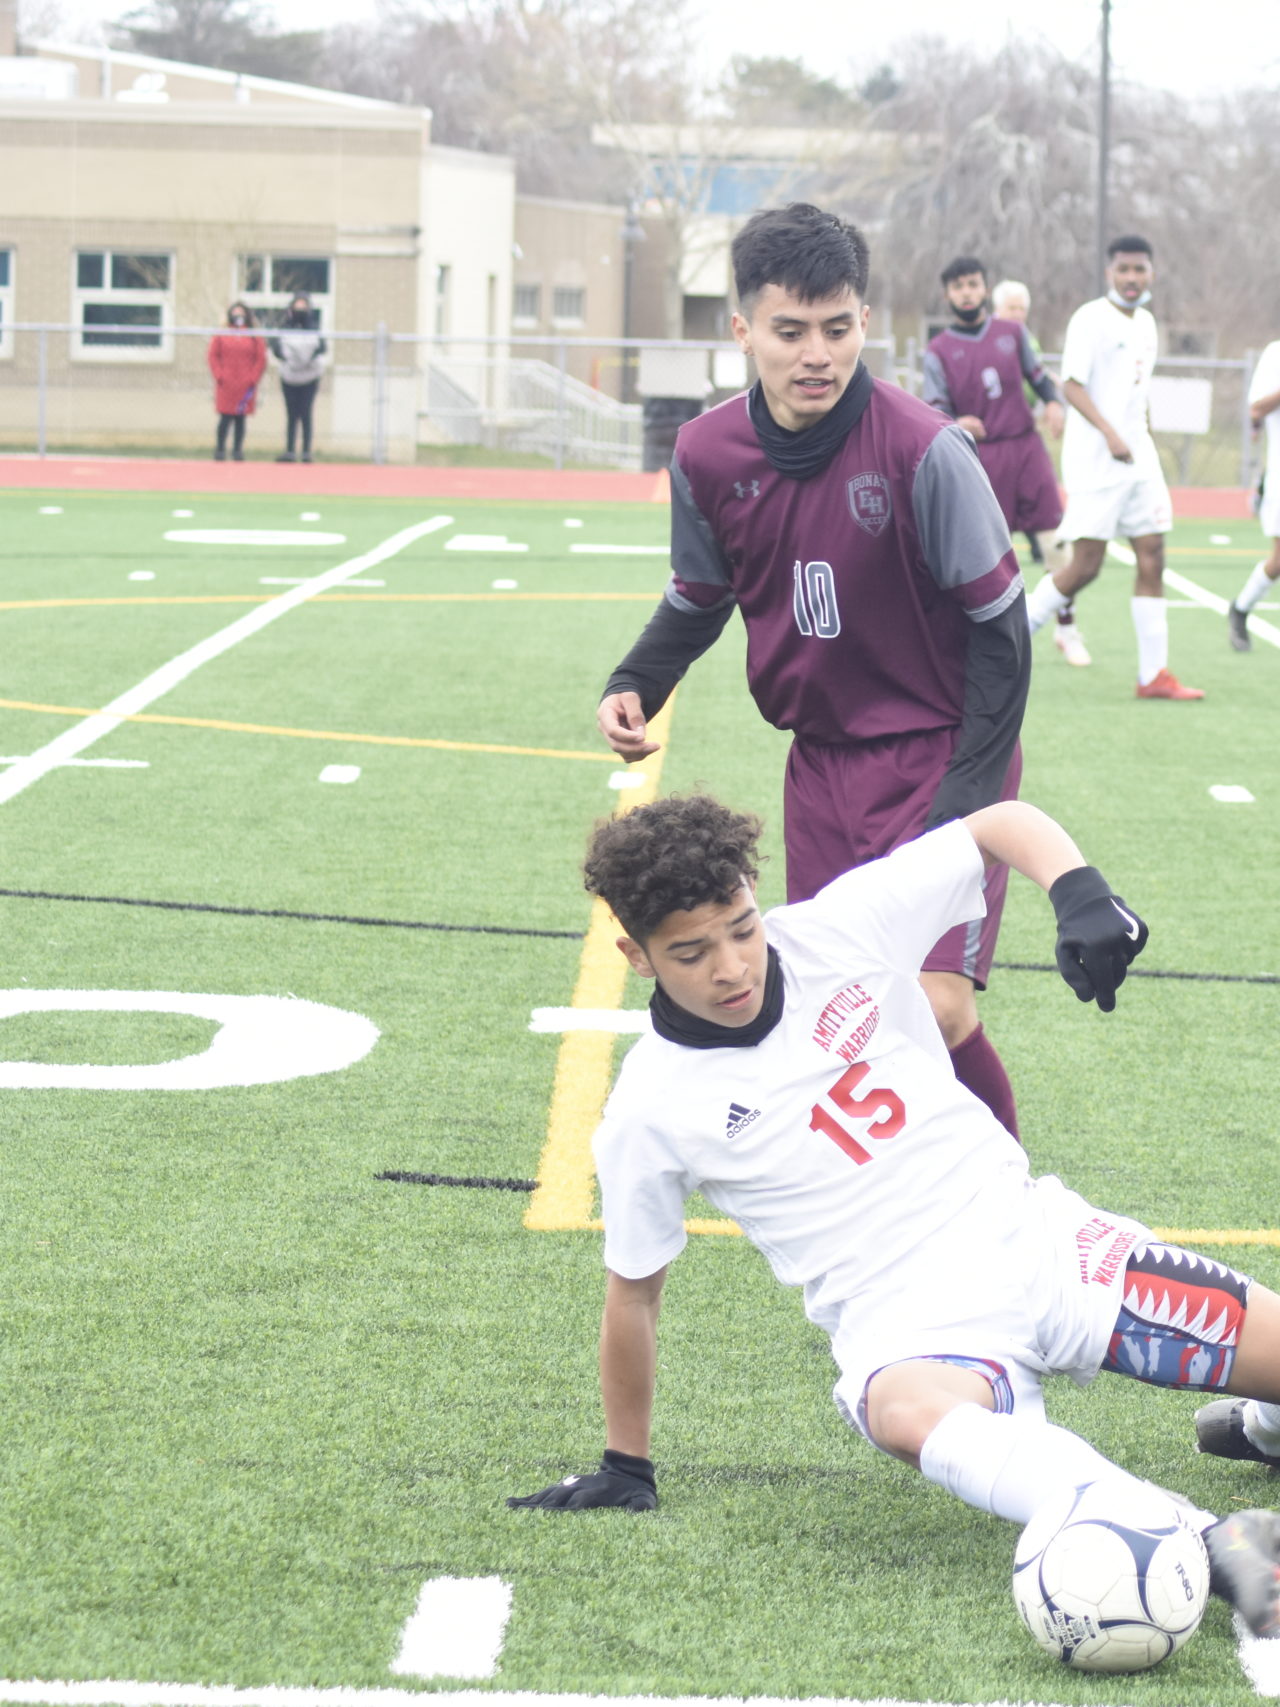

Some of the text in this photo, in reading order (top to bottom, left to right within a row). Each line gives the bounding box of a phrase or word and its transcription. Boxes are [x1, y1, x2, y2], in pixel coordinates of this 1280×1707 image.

[981, 366, 1002, 400] 9
[793, 559, 841, 639] 10
[812, 983, 872, 1052] AMITYVILLE
[836, 1005, 881, 1064] WARRIORS
[726, 1109, 762, 1139] adidas
[809, 1060, 907, 1166] 15
[1091, 1231, 1138, 1288] WARRIORS
